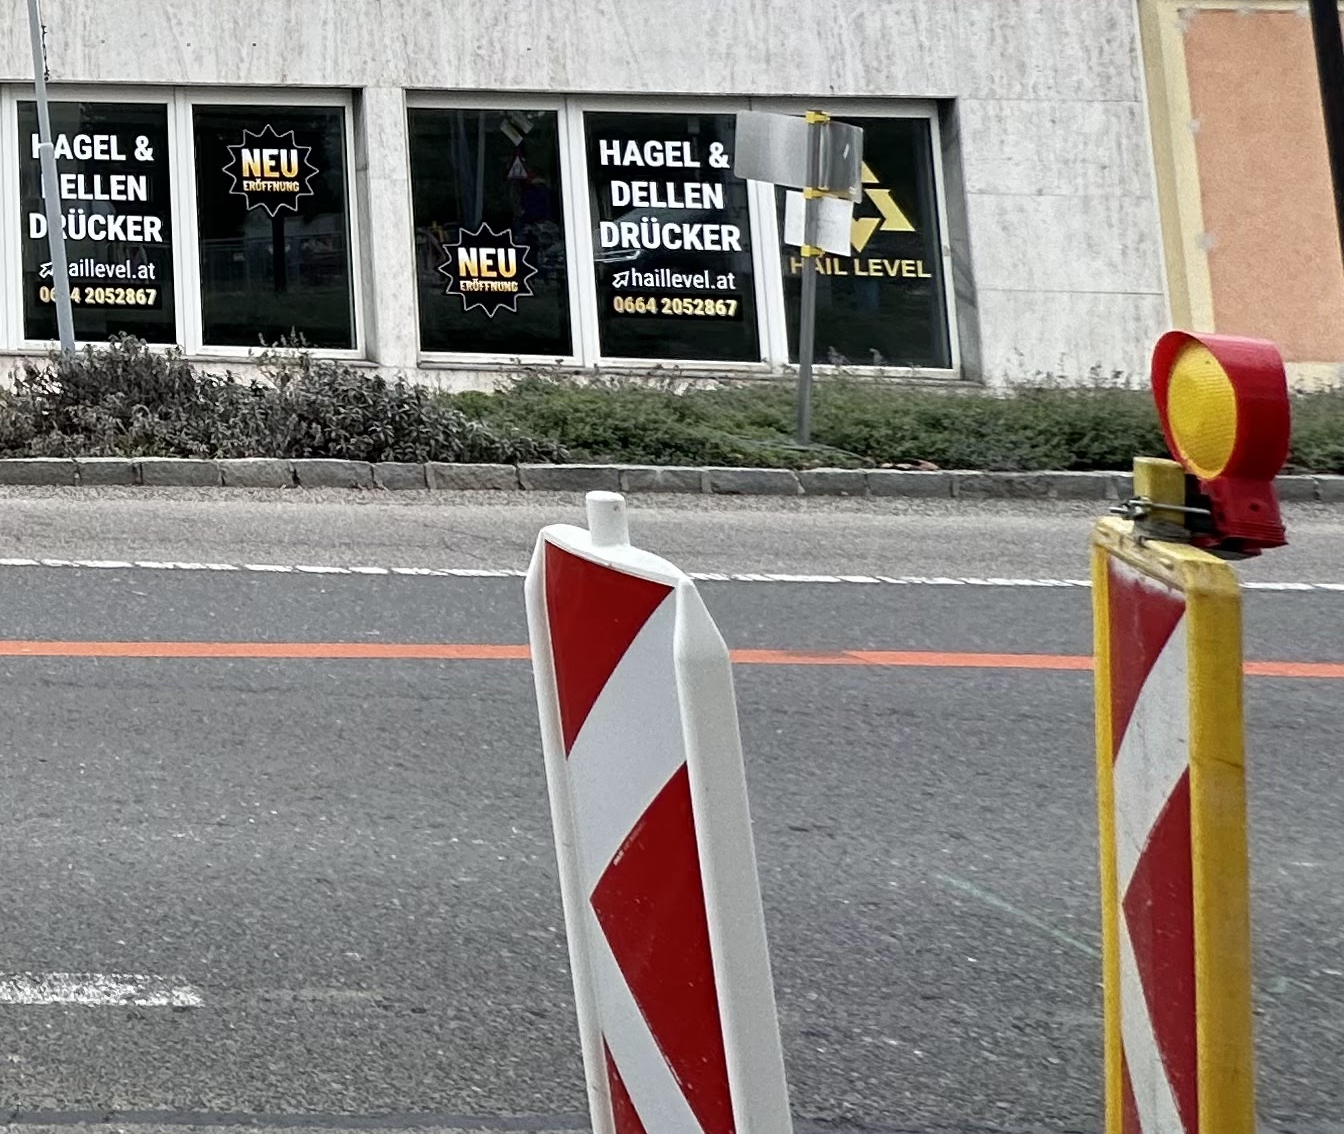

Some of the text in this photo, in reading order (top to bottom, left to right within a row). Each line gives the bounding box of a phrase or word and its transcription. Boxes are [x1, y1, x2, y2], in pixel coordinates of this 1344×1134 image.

[134, 135, 154, 161] &
[599, 139, 730, 169] HAGEL &
[241, 148, 299, 179] NEU
[41, 173, 148, 202] ELLEN
[242, 178, 300, 193] ERÖFFNUNG
[610, 180, 724, 210] DELLEN
[599, 216, 742, 252] DRÜCKER
[68, 258, 156, 280] aillevel.at
[457, 247, 517, 278] NEU
[853, 258, 932, 278] LEVEL
[459, 277, 519, 292] ERÖFFNUNG
[631, 267, 736, 290] haillevel.at
[84, 286, 158, 306] 2052867
[613, 295, 738, 316] 0664 2052867
